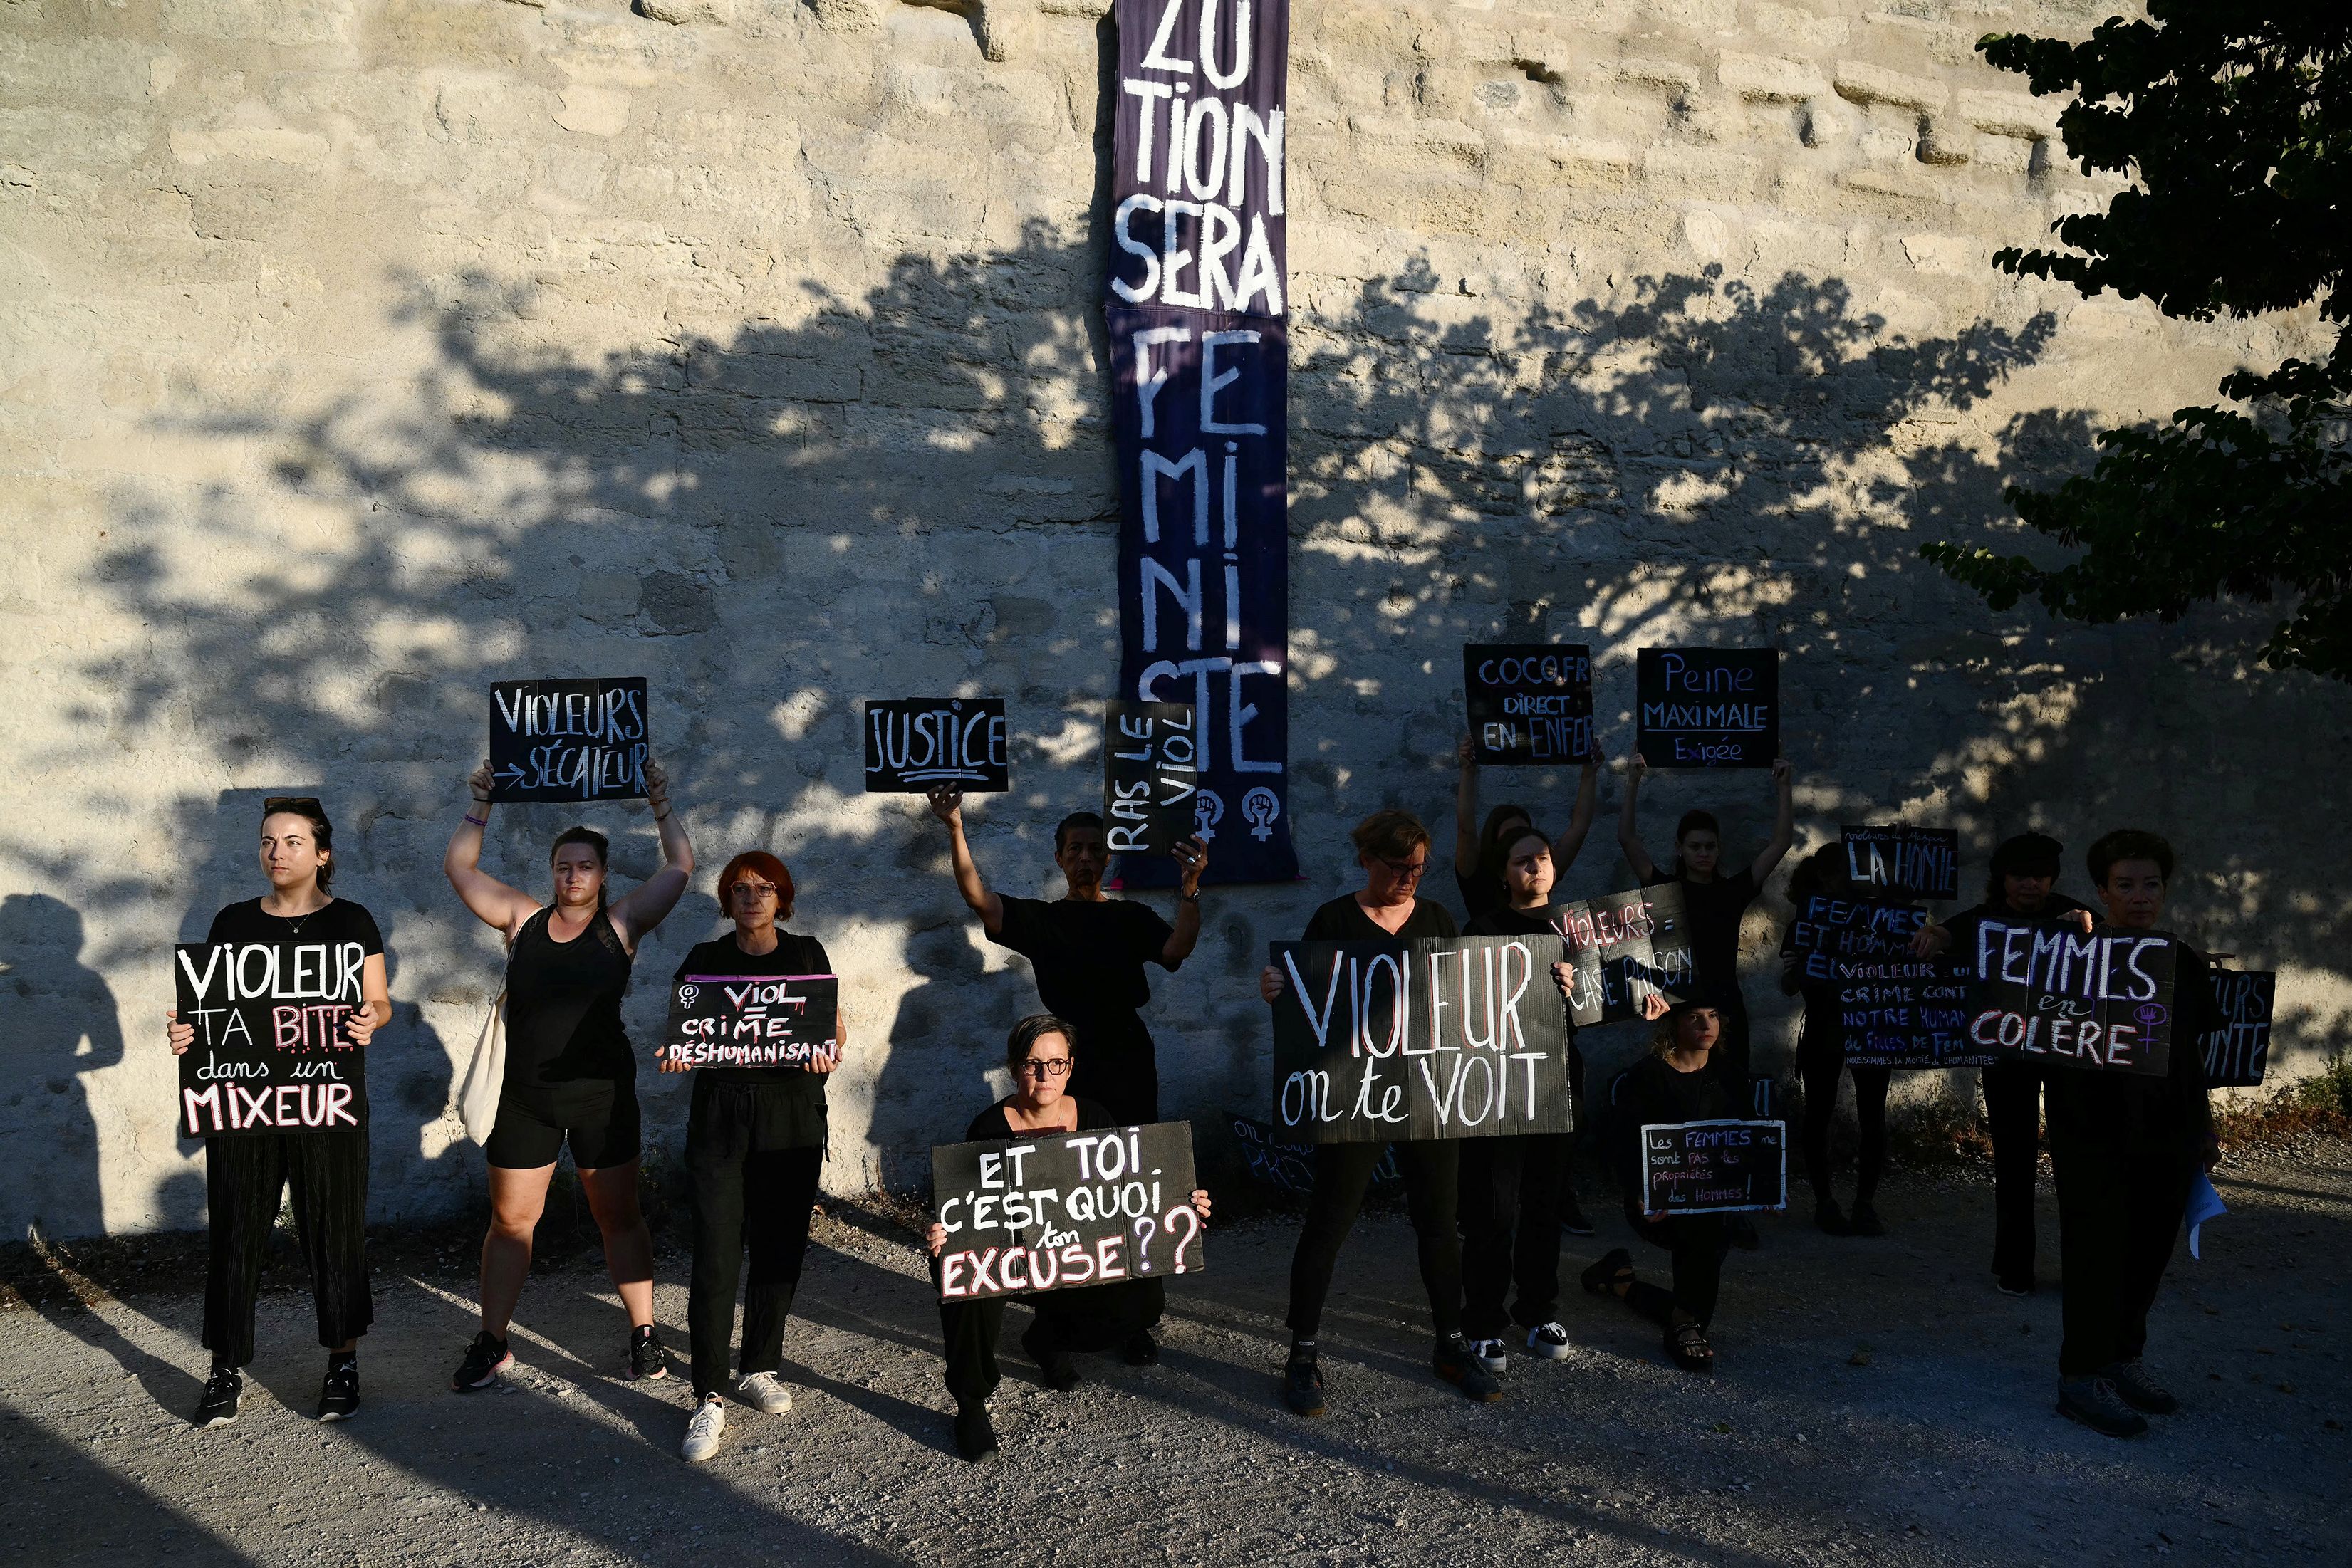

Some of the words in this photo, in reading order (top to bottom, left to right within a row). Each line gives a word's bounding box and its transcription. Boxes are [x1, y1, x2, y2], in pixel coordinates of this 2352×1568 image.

[1110, 193, 1282, 315] SERA
[1133, 327, 1268, 439] FE
[1661, 653, 1754, 693] Peine
[1114, 714, 1152, 761] LE
[1484, 722, 1516, 751] EN
[1529, 715, 1593, 758] ENFER
[1675, 736, 1743, 766] Exigée
[520, 738, 650, 798] SÉCATEUR
[1107, 780, 1150, 850] RAS
[1848, 842, 1888, 887] LA
[1795, 921, 1831, 947] ET
[1808, 894, 1927, 935] FEMMES
[1979, 920, 2168, 1000] FEMMES
[1284, 941, 1532, 1058] VIOLEUR
[1843, 1008, 1910, 1026] NOTRE
[2038, 995, 2092, 1015] en
[2210, 974, 2267, 1023] URS
[187, 1008, 252, 1046] TA
[1912, 1035, 1929, 1050] DE
[197, 1050, 269, 1080] dans
[290, 1061, 344, 1080] un
[1281, 1069, 1343, 1126] on
[1351, 1055, 1410, 1123] te
[1419, 1052, 1549, 1127] VOIT
[1650, 1151, 1681, 1165] sont
[1688, 1152, 1709, 1166] PAS
[1685, 1130, 1752, 1148] FEMMES
[979, 1145, 1036, 1188] ET
[940, 1188, 1058, 1233] C'EST
[1668, 1188, 1686, 1203] des
[1695, 1188, 1743, 1202] HOMMES
[1035, 1221, 1080, 1249] ton
[942, 1234, 1126, 1297] EXCUSE
